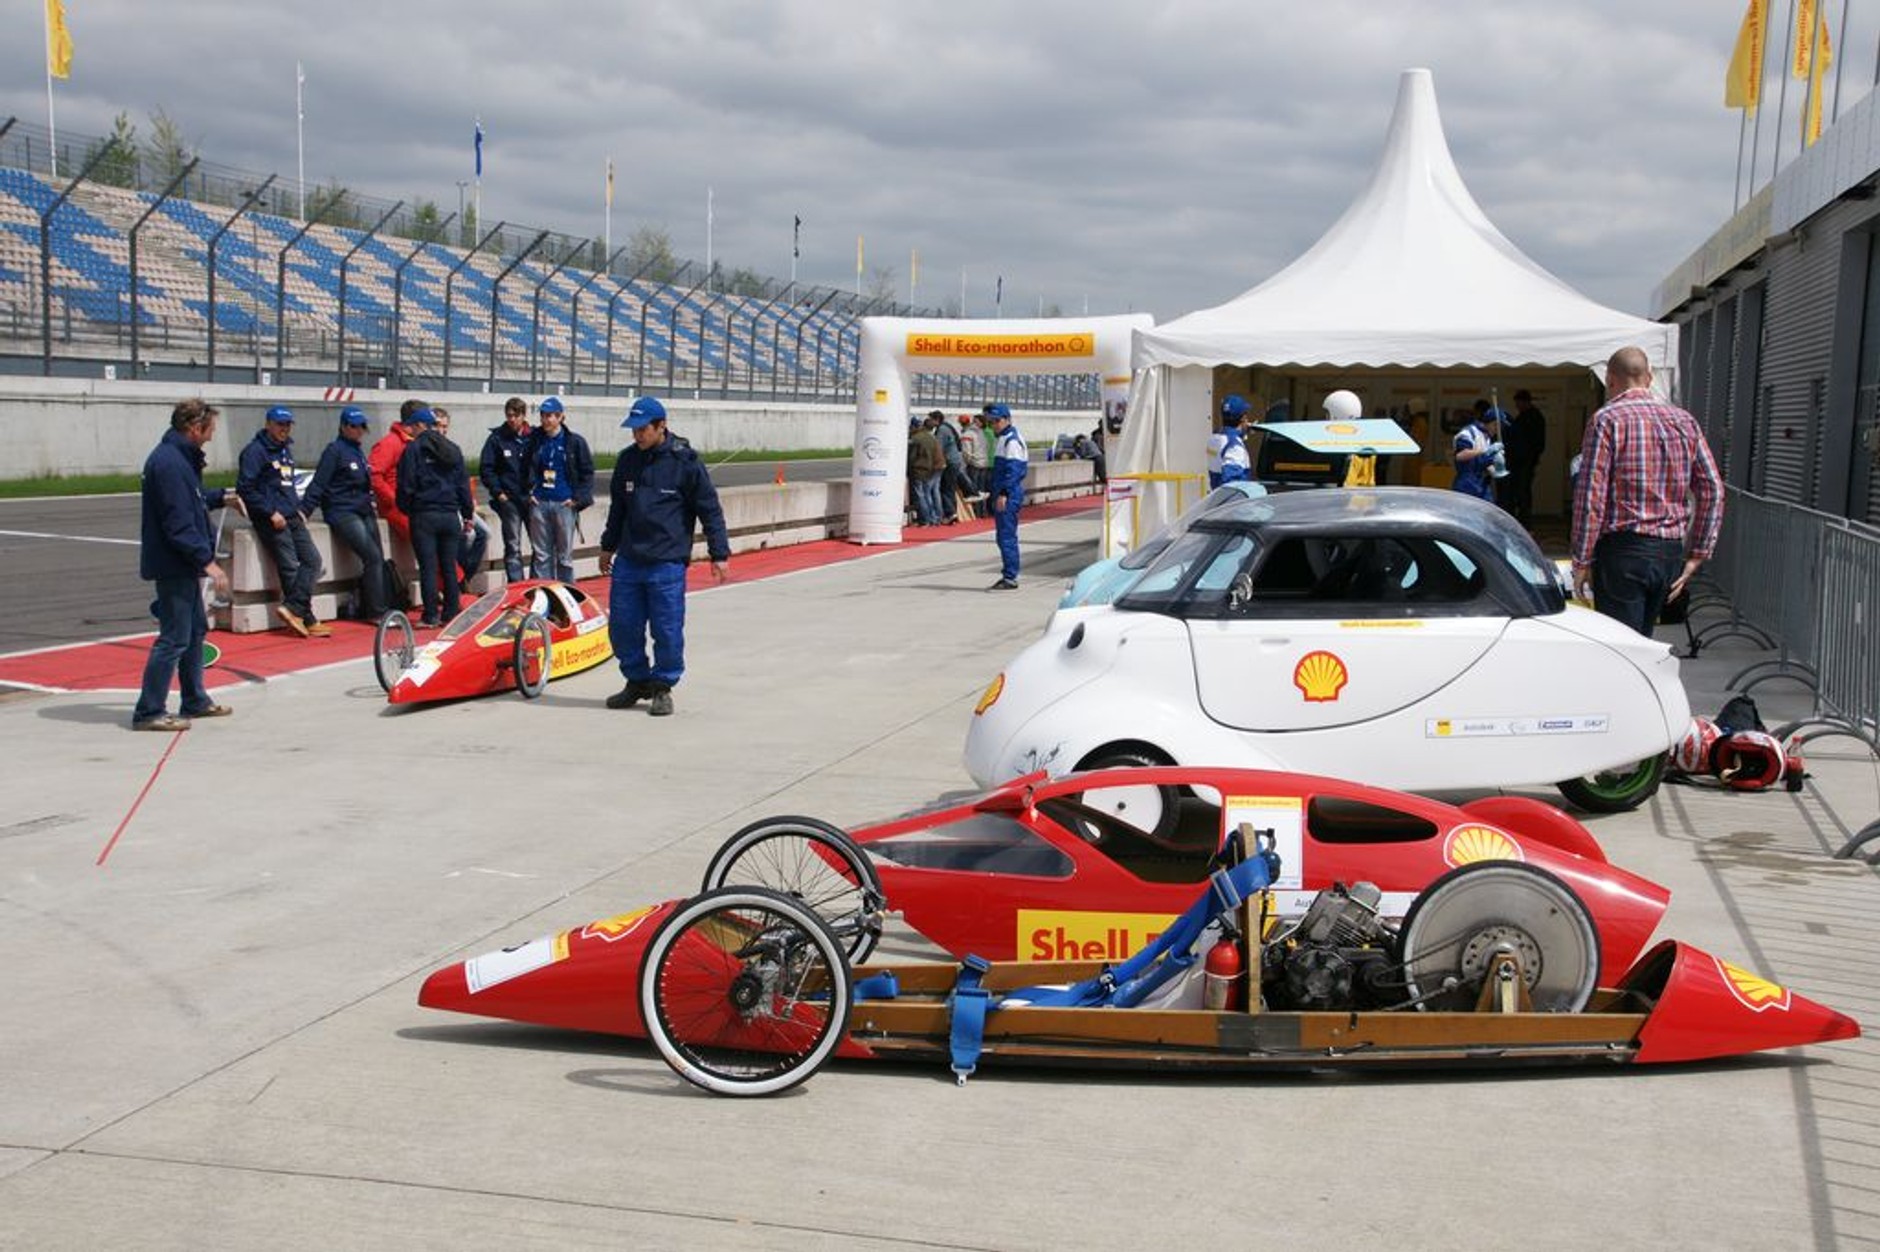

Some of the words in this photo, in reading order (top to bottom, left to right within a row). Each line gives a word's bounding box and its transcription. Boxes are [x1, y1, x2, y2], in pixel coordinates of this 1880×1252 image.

[914, 337, 951, 353] Shell
[956, 338, 1065, 354] Eco-marathon
[1032, 926, 1129, 961] Shell
